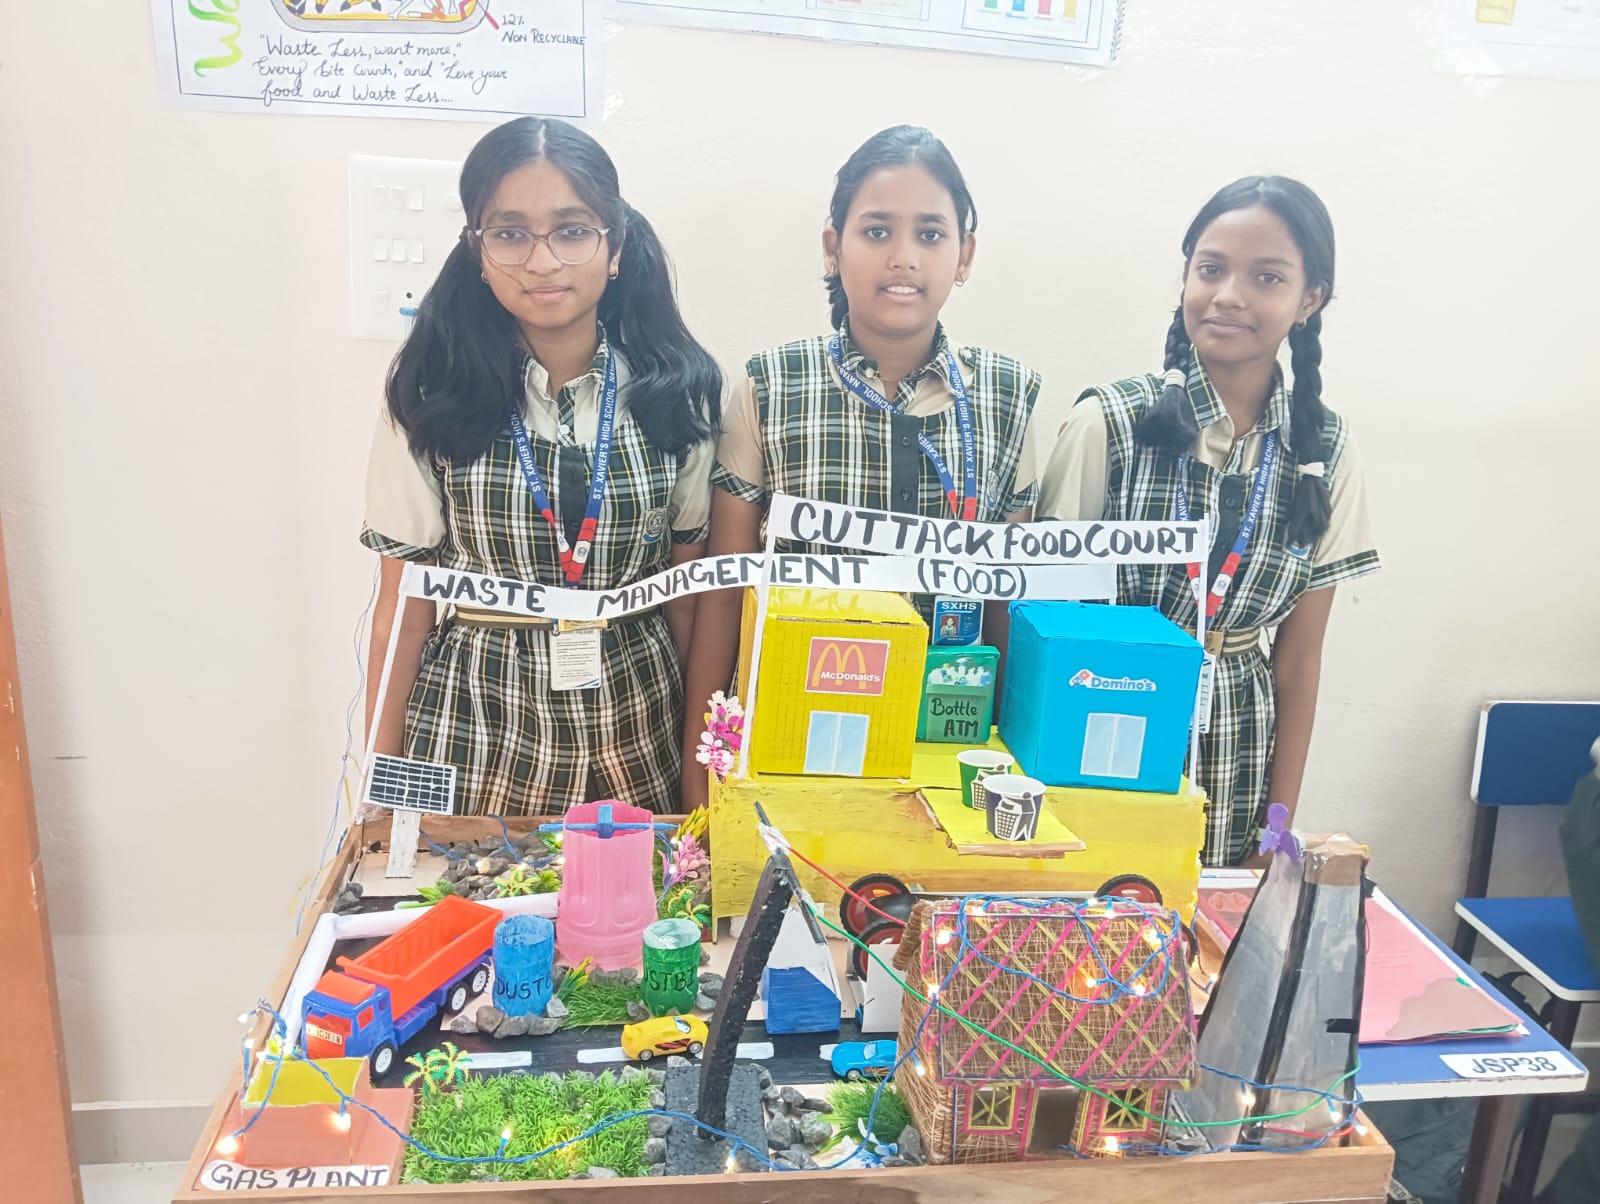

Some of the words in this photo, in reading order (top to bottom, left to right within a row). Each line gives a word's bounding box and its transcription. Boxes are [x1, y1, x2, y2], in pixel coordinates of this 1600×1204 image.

[501, 14, 525, 26] 12%
[502, 30, 527, 43] NON
[530, 28, 586, 46] RECYCLABLE
[374, 41, 412, 56] want
[252, 56, 307, 88] Every
[404, 61, 432, 78] and
[261, 80, 303, 107] food
[313, 85, 341, 98] and
[353, 85, 396, 101] Waste
[959, 400, 969, 421] HIGH
[601, 420, 611, 440] HIGH
[517, 437, 537, 476] XAVIER'S
[595, 442, 608, 483] XAVIER'S
[593, 484, 604, 500] ST.
[1248, 485, 1265, 524] XAVIER'S
[1260, 463, 1269, 485] HIGH
[790, 502, 994, 559] CUTTACK
[423, 570, 546, 612] WASTE
[596, 556, 869, 617] MANAGEMENT
[917, 557, 1027, 600] (FOOD)
[941, 602, 977, 610] SXHS
[820, 671, 880, 682] McDonald's
[1091, 677, 1153, 691] Domino's
[930, 697, 977, 716] Bottle
[944, 719, 979, 738] ATM
[1472, 1056, 1557, 1074] JSP38
[211, 1164, 278, 1190] GAS
